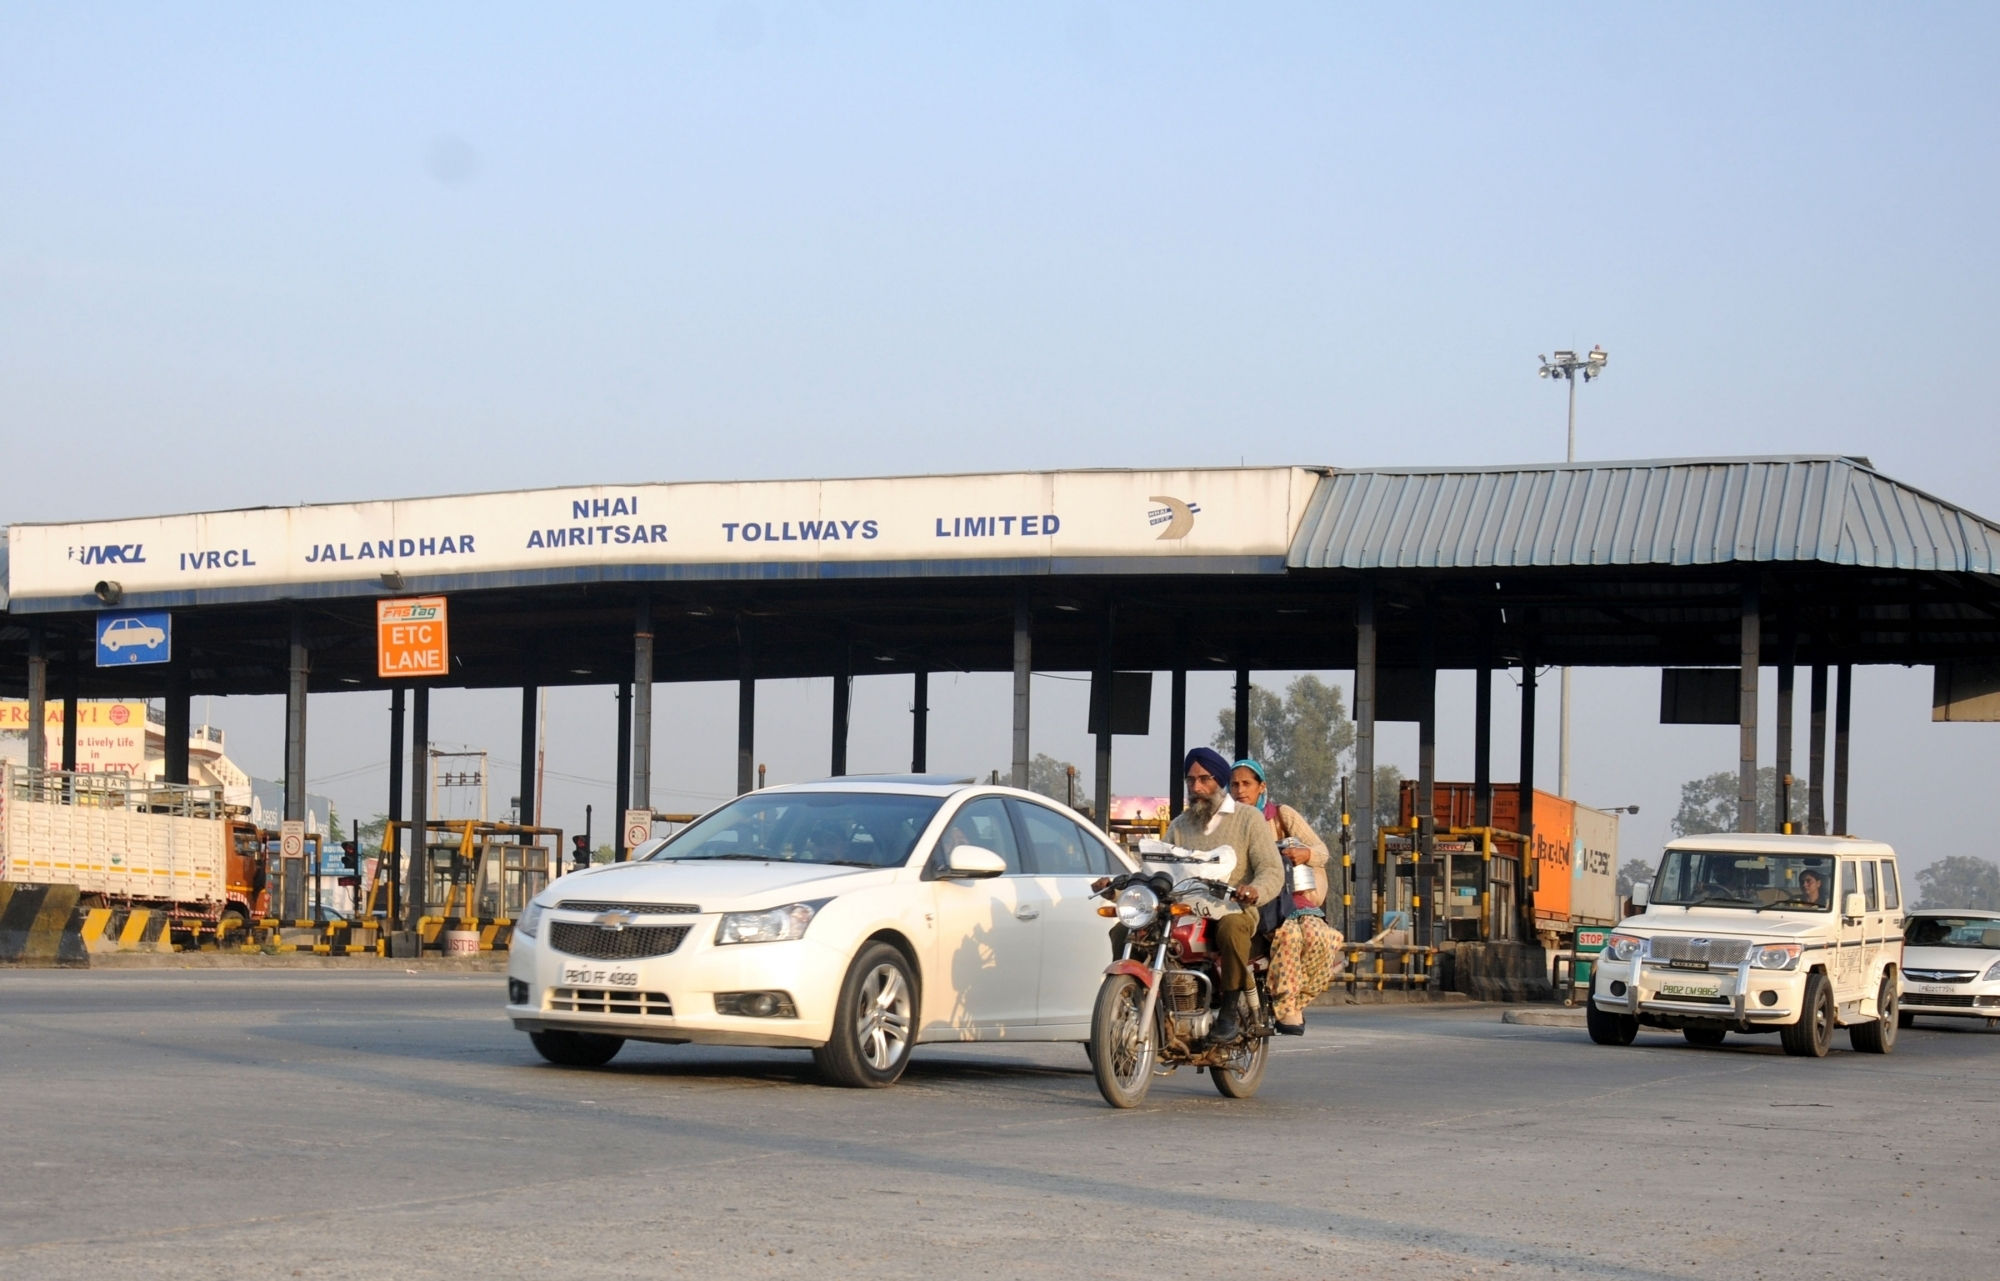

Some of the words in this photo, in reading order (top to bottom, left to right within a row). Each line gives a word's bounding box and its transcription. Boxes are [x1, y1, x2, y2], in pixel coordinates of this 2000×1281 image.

[573, 496, 638, 519] NHAI
[180, 549, 256, 571] IVRCL
[305, 535, 475, 563] JALANDHAR
[527, 525, 668, 548] AMRITSAR
[722, 520, 879, 542] TOLLWAYS
[936, 514, 1061, 537] LIMITED
[392, 625, 432, 645] ETC
[385, 649, 441, 670] LANE
[117, 738, 134, 747] Life
[91, 750, 100, 759] in
[1579, 933, 1603, 944] STOP
